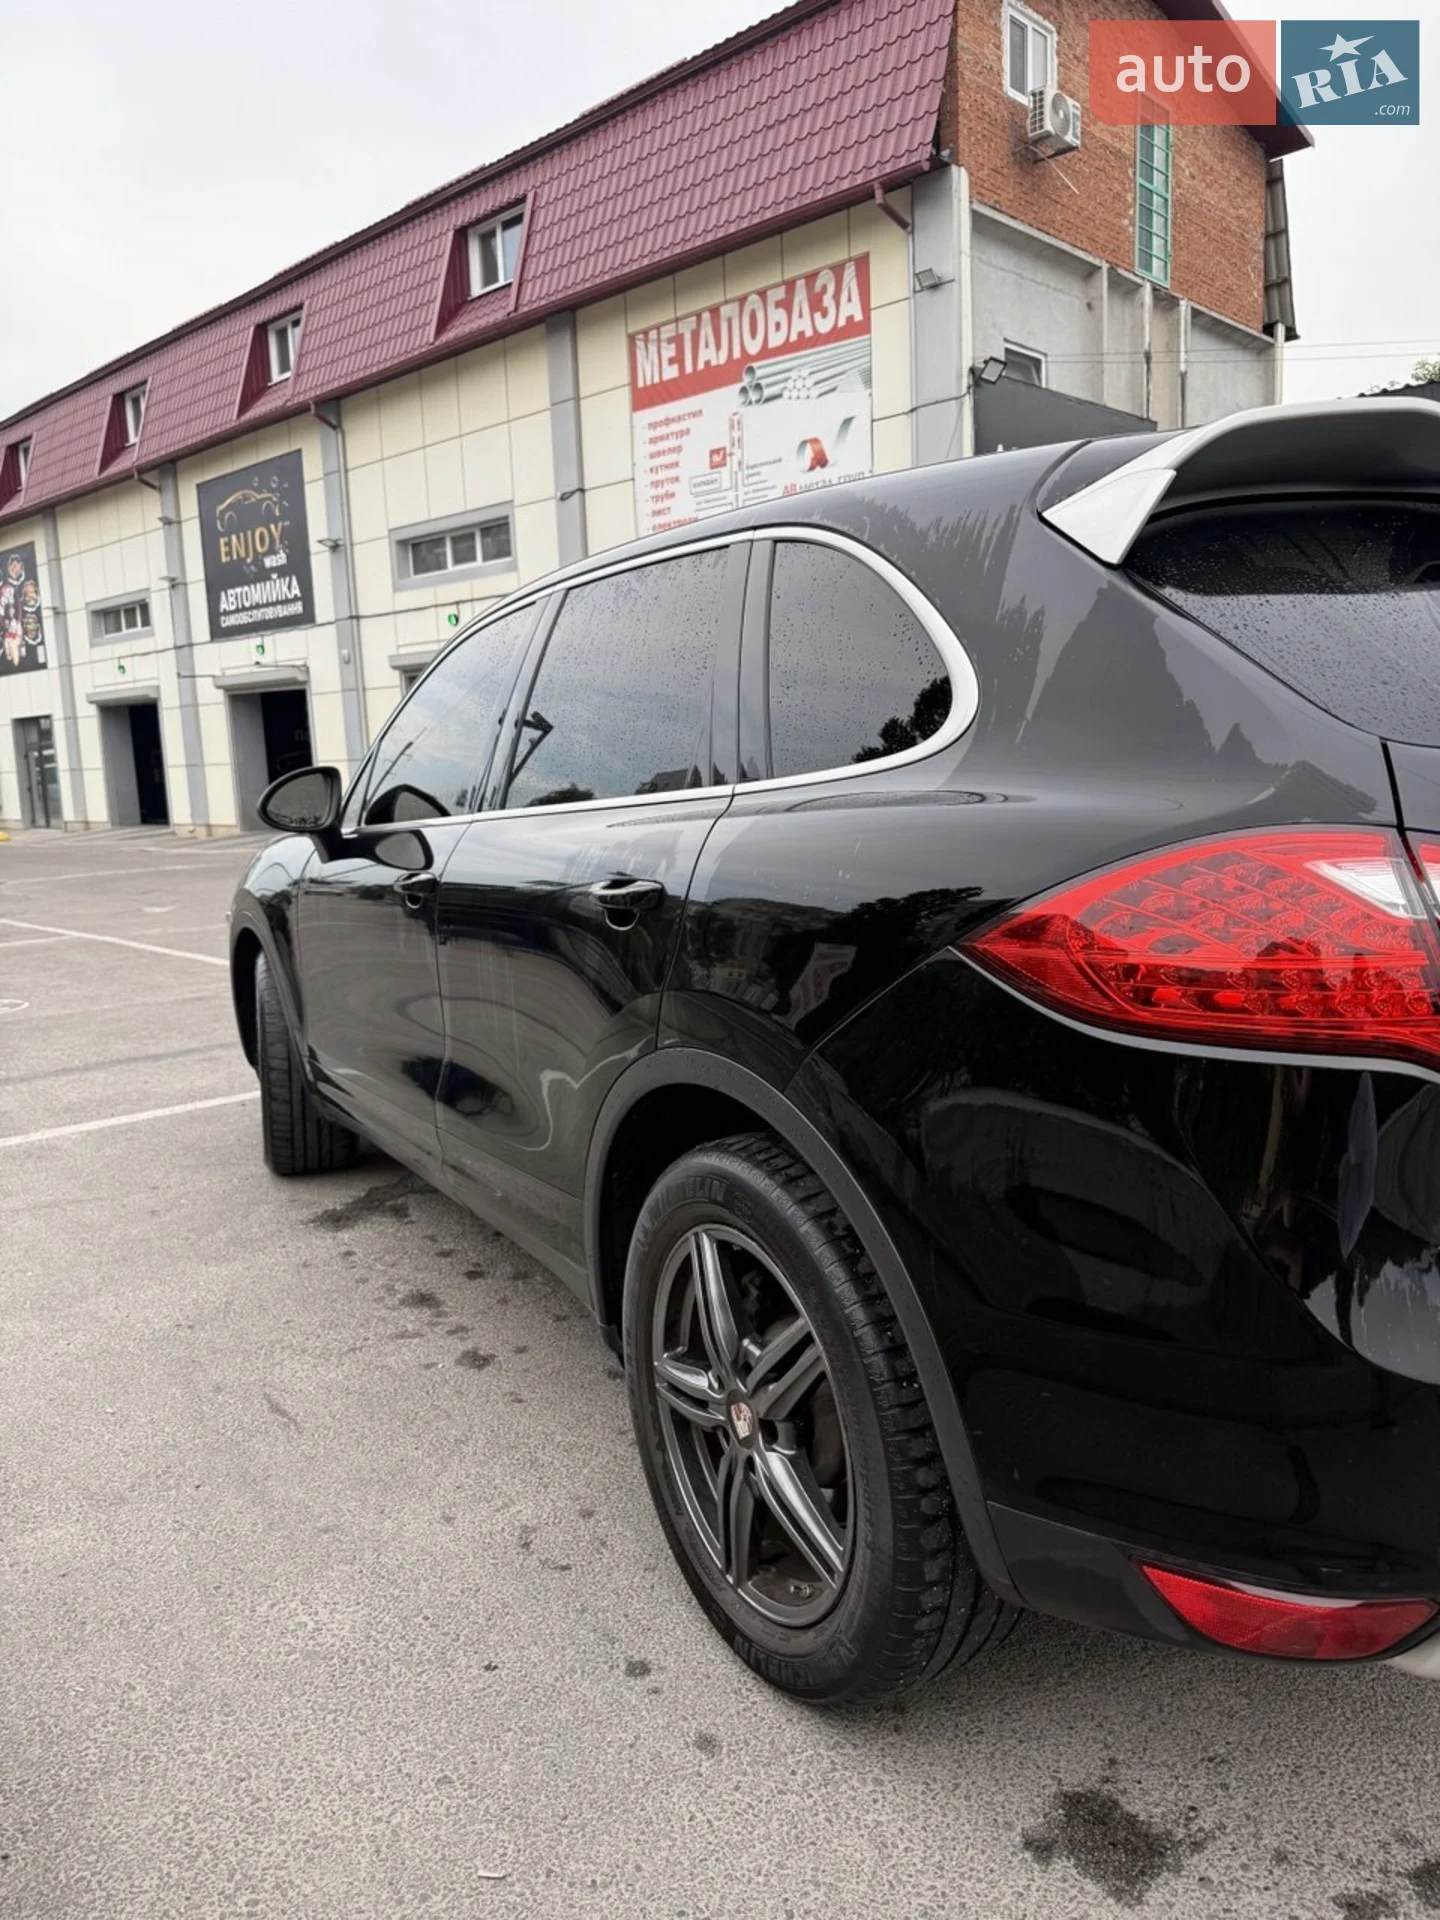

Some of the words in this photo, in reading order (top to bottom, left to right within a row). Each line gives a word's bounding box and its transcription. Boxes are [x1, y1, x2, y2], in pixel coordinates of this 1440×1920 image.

[634, 261, 864, 388] МЕТАЛОБАЗА
[648, 428, 690, 446] арматура
[650, 476, 679, 490] пруток
[219, 522, 283, 563] ENJOY
[264, 551, 287, 568] wash
[219, 573, 301, 612] АВТОМИЙКА
